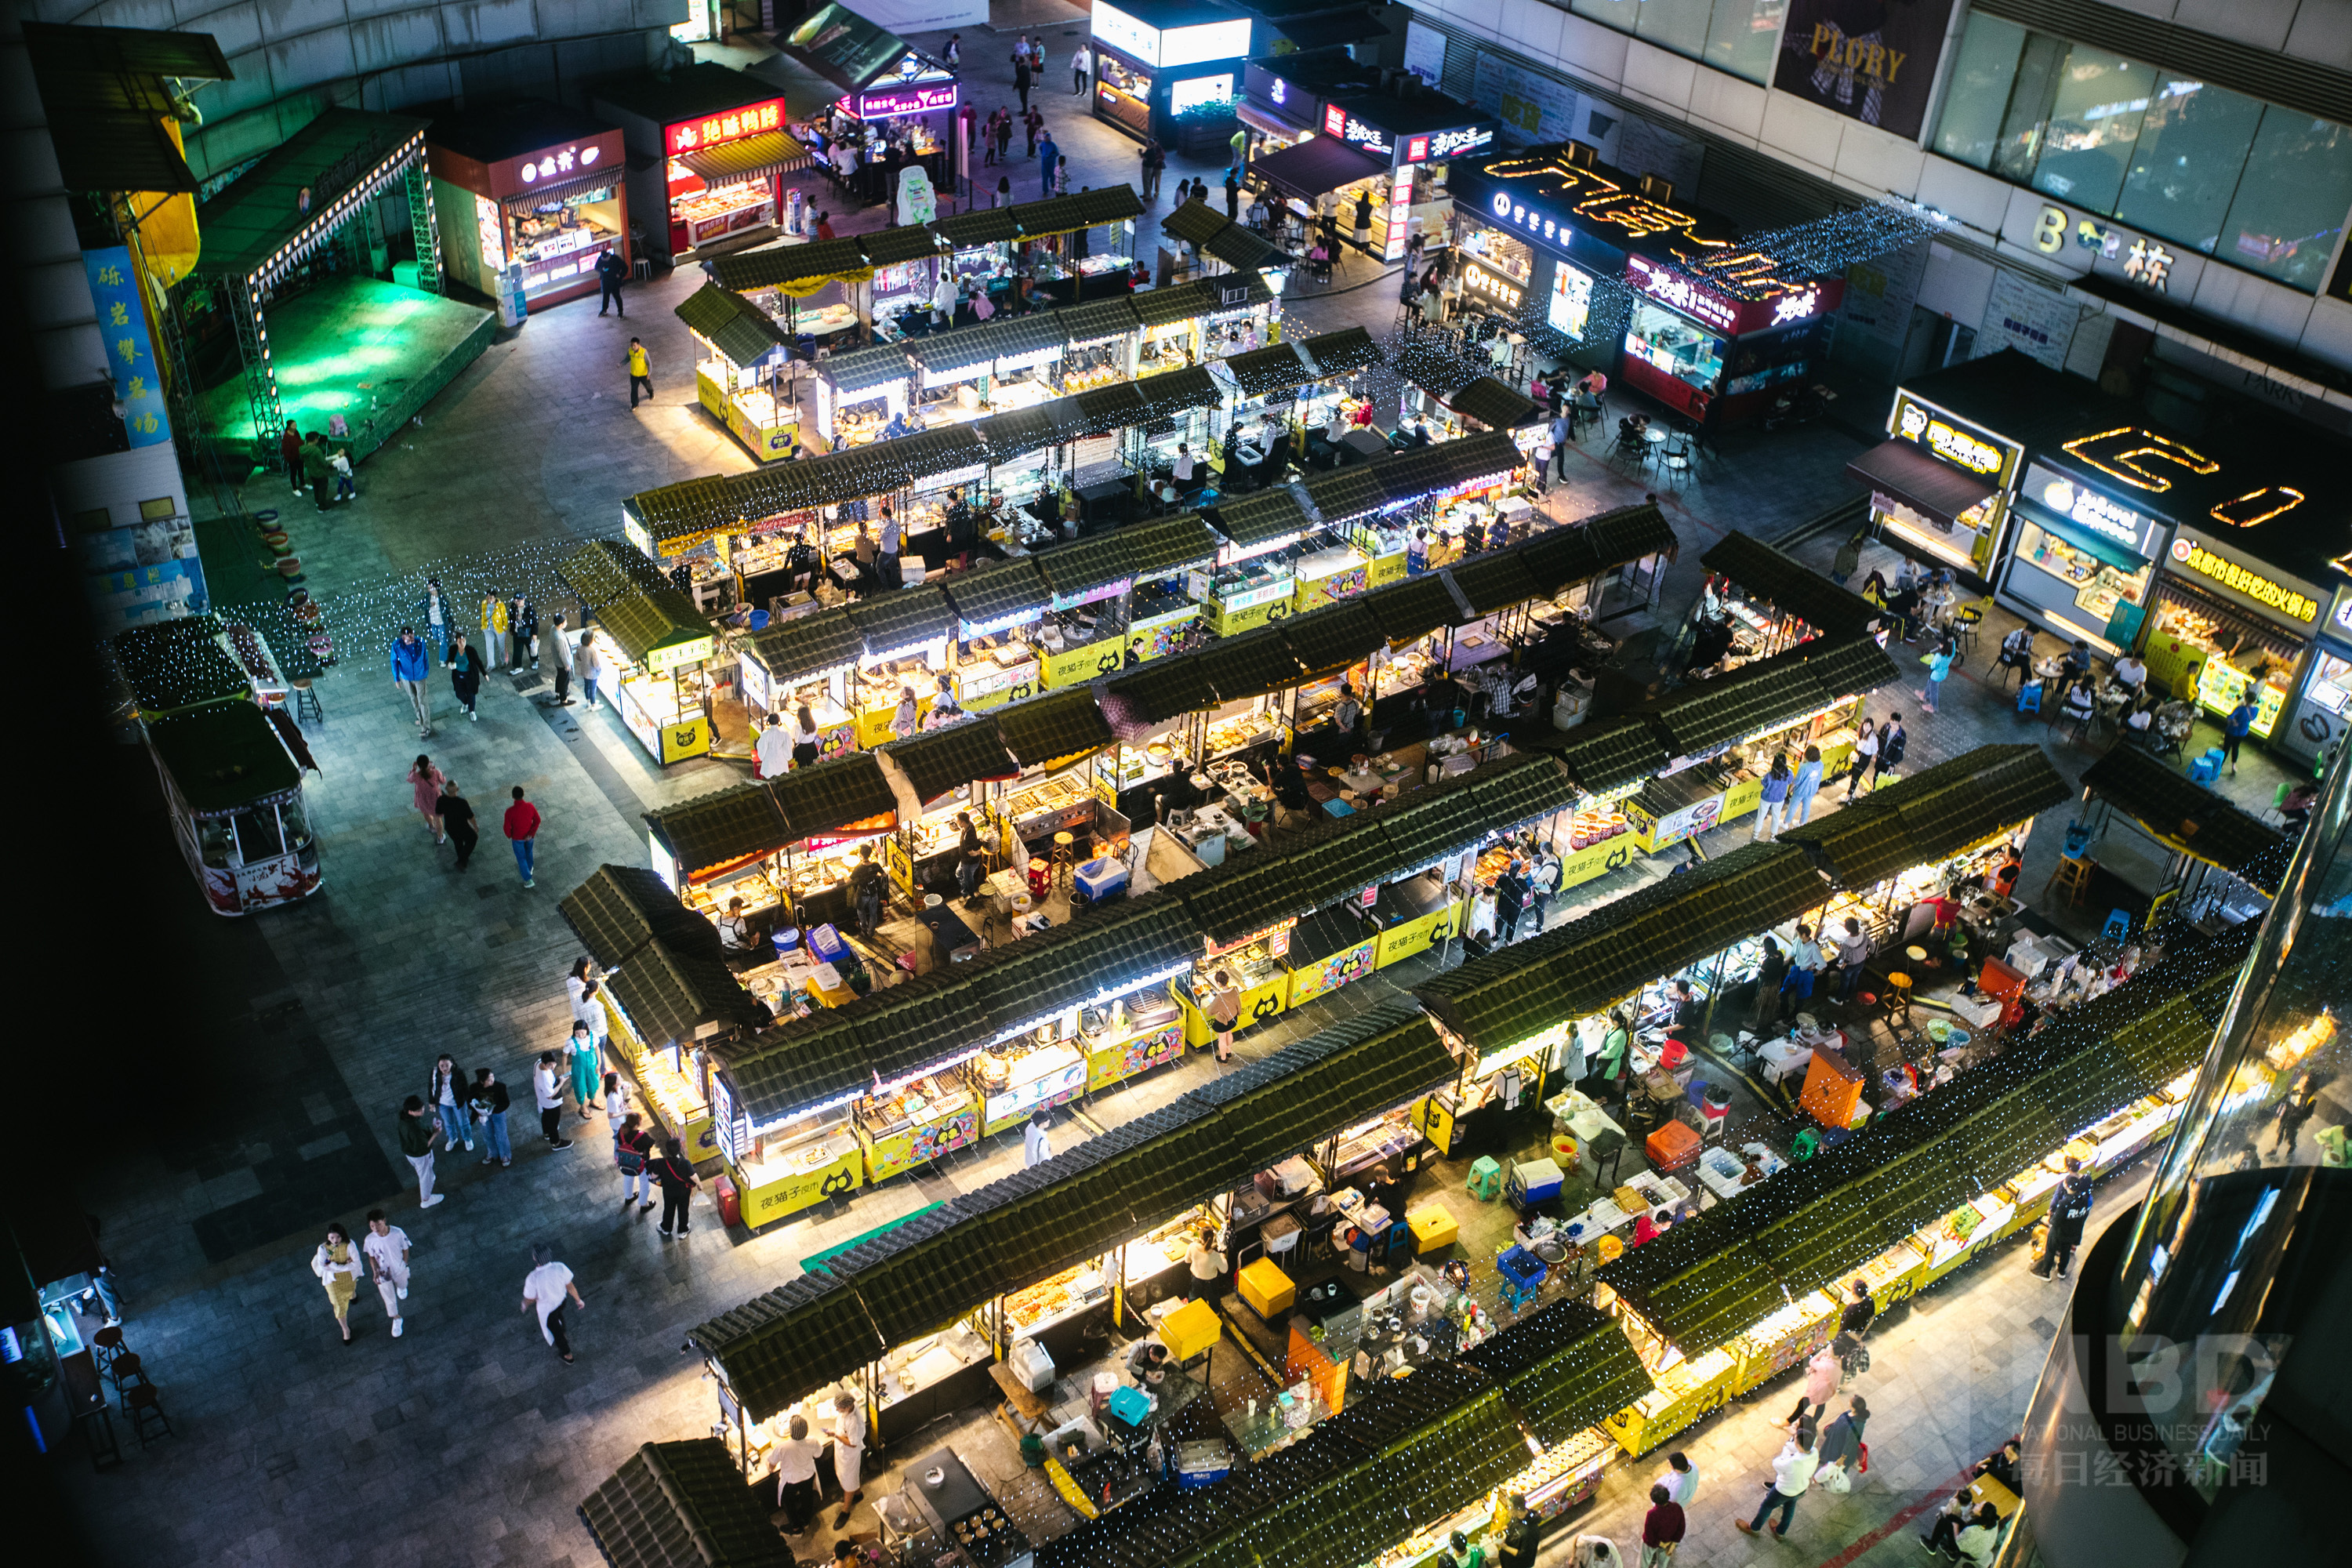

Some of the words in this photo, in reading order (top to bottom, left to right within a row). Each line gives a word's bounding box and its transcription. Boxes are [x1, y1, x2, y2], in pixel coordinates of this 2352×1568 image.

[1810, 23, 1907, 84] PLORY
[2034, 203, 2067, 253] B
[2123, 238, 2174, 294] 栋
[2186, 547, 2318, 622] 成都市很好吃的火锅粉
[760, 1181, 818, 1210] 夜猫子夜市
